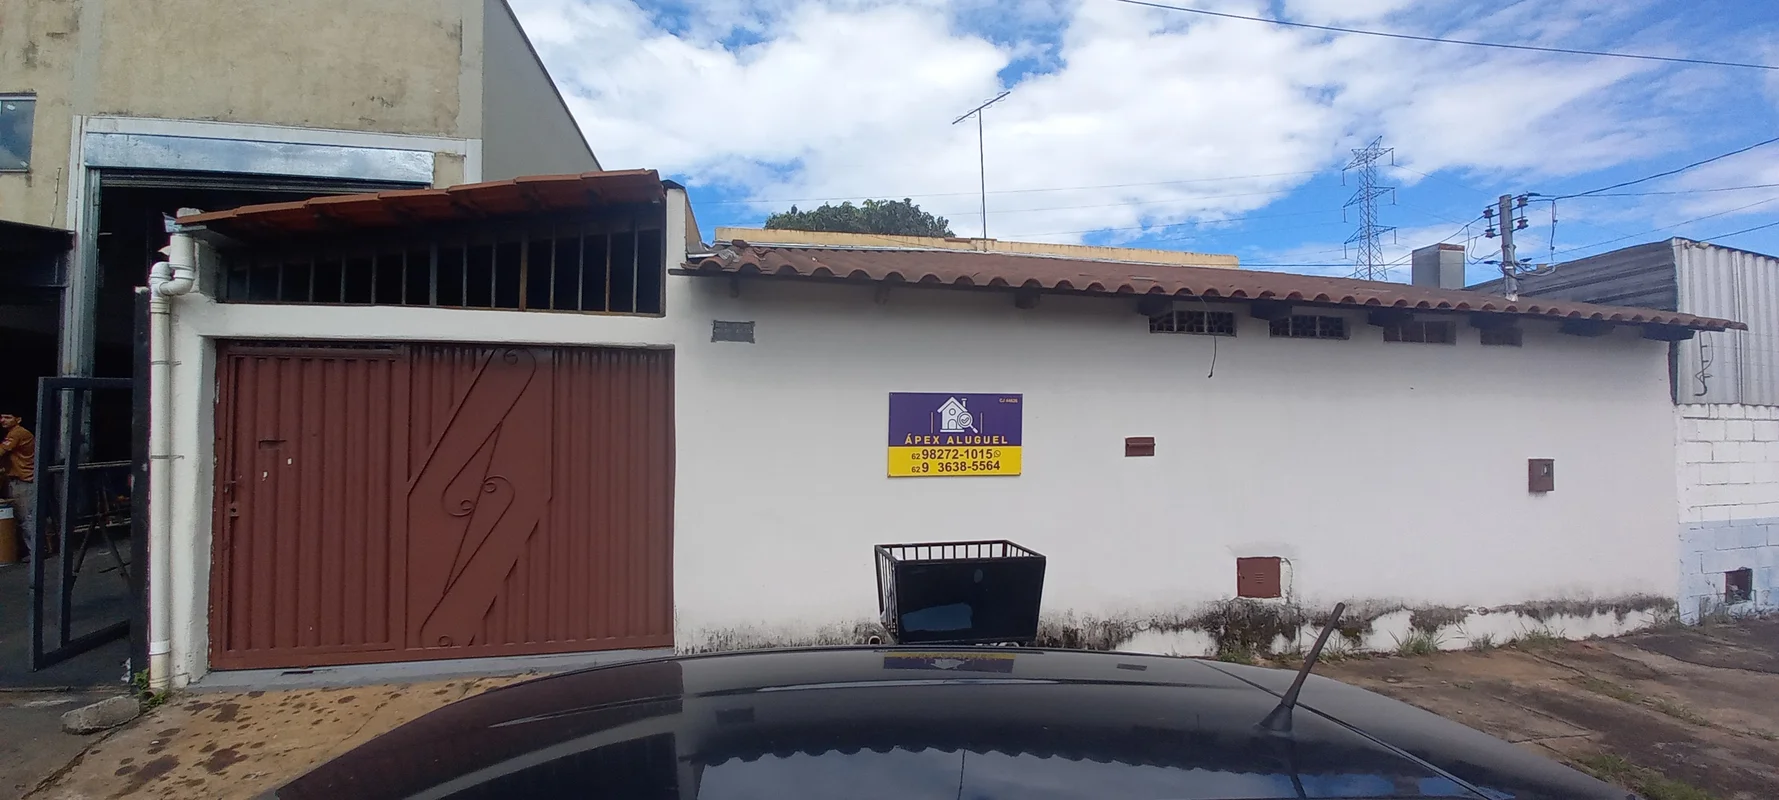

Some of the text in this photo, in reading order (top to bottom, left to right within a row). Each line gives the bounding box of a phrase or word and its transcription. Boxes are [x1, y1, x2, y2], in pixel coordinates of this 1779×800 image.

[905, 433, 1008, 444] ÁPEX ALUGUEL
[921, 449, 993, 460] 98272-1015
[937, 460, 1000, 472] 3638-5564
